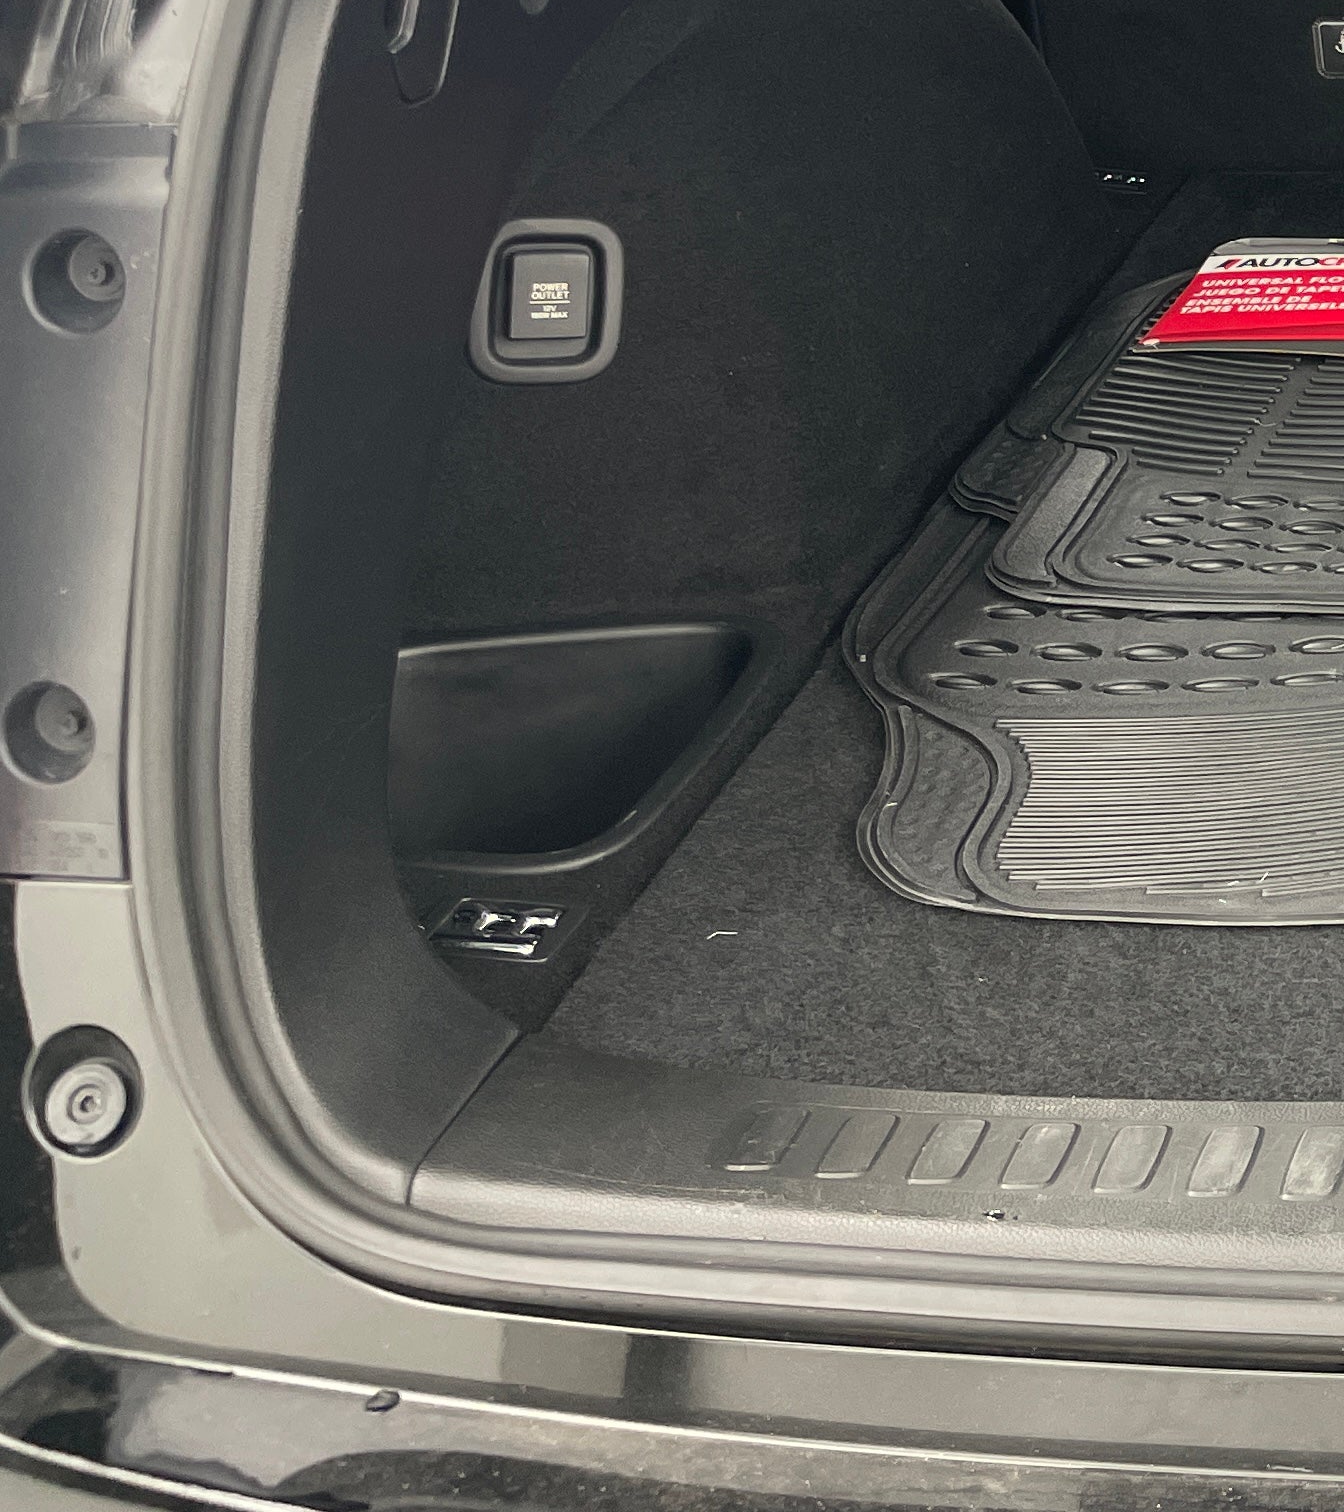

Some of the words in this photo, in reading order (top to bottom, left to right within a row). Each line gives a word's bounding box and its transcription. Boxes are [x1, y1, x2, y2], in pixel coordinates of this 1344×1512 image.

[533, 282, 569, 292] POWER
[1202, 277, 1304, 287] UNIVERSAL
[531, 290, 570, 300] OUTLET
[1193, 287, 1261, 297] JUEGO
[1265, 286, 1291, 295] DE
[1185, 296, 1282, 307] ENSEMBLE
[1285, 295, 1313, 303] DE
[1180, 304, 1233, 315] TAPIS
[550, 311, 569, 319] MAX
